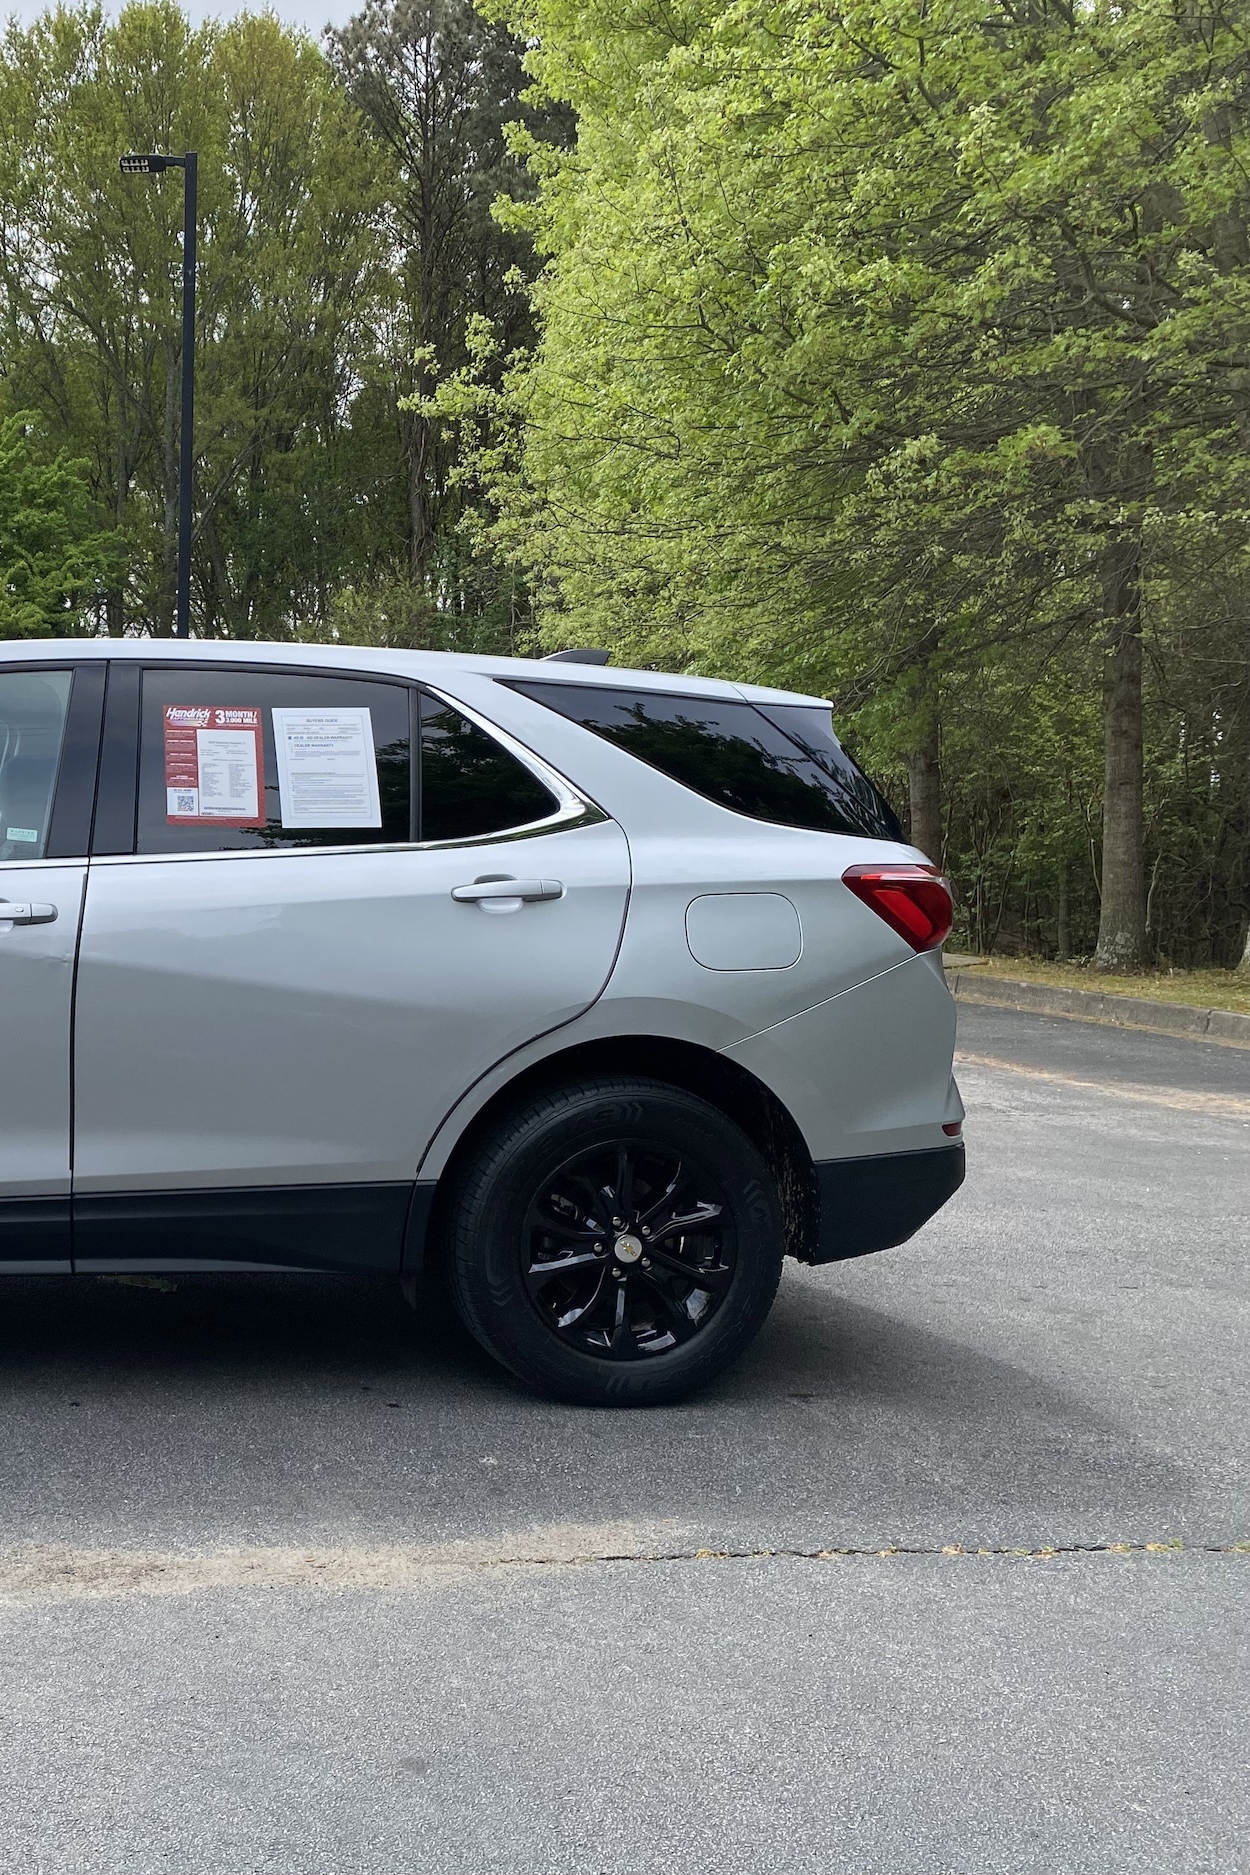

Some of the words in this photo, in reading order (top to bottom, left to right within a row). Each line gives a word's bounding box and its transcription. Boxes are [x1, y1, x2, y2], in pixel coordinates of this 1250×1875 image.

[165, 707, 211, 720] Hendrick
[215, 710, 225, 724] 3
[225, 710, 257, 718] MONTH/
